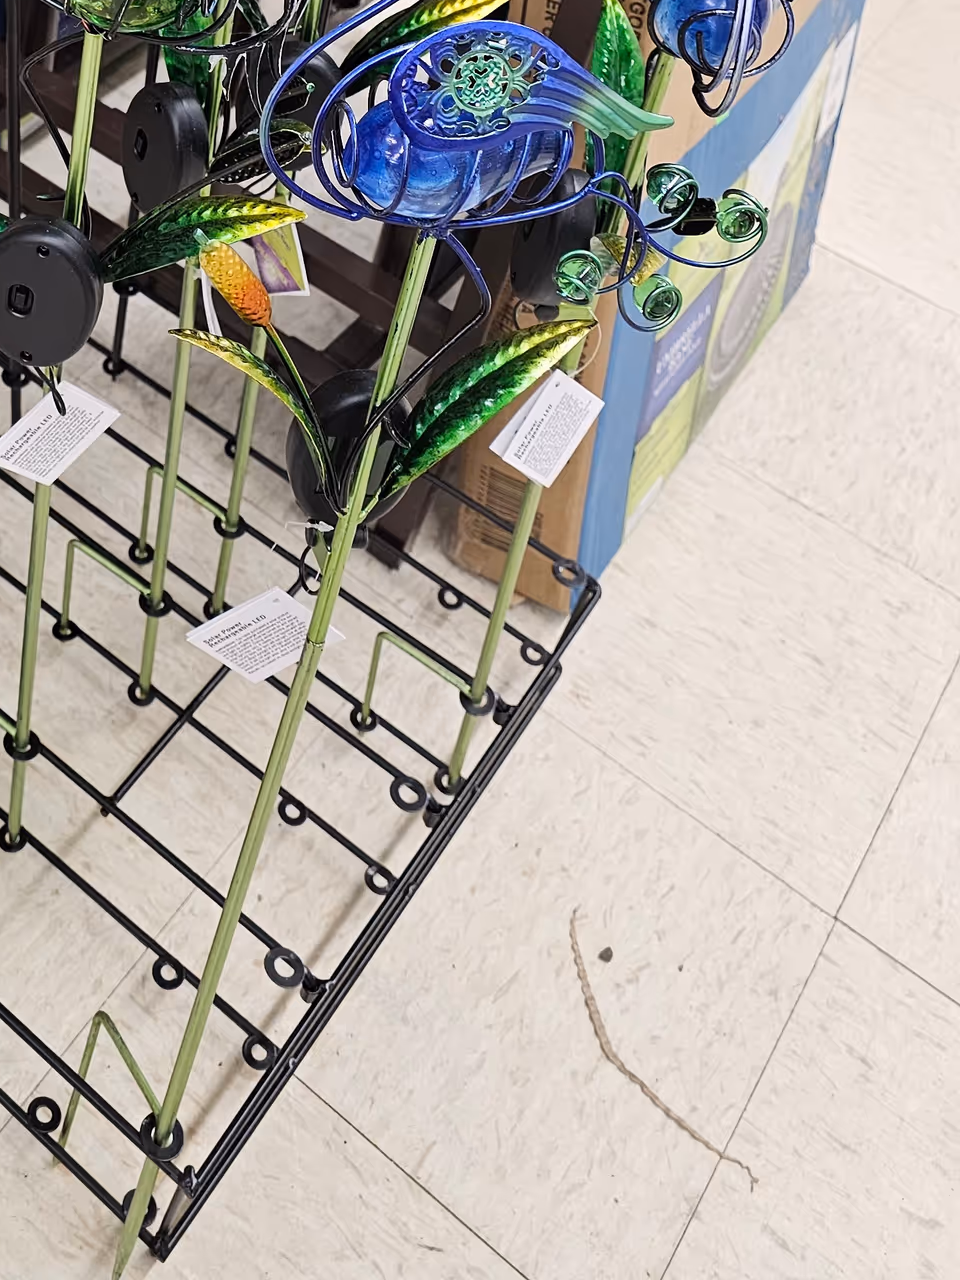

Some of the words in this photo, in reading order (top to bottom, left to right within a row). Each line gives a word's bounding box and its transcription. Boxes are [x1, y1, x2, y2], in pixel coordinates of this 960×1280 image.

[0, 443, 17, 460] Solar
[15, 427, 34, 445] Power
[4, 425, 42, 462] Rechargeable
[40, 413, 54, 427] LED
[203, 632, 222, 645] Solar
[221, 620, 243, 635] Power
[207, 622, 253, 649] Rechargeable
[252, 613, 267, 625] LED
